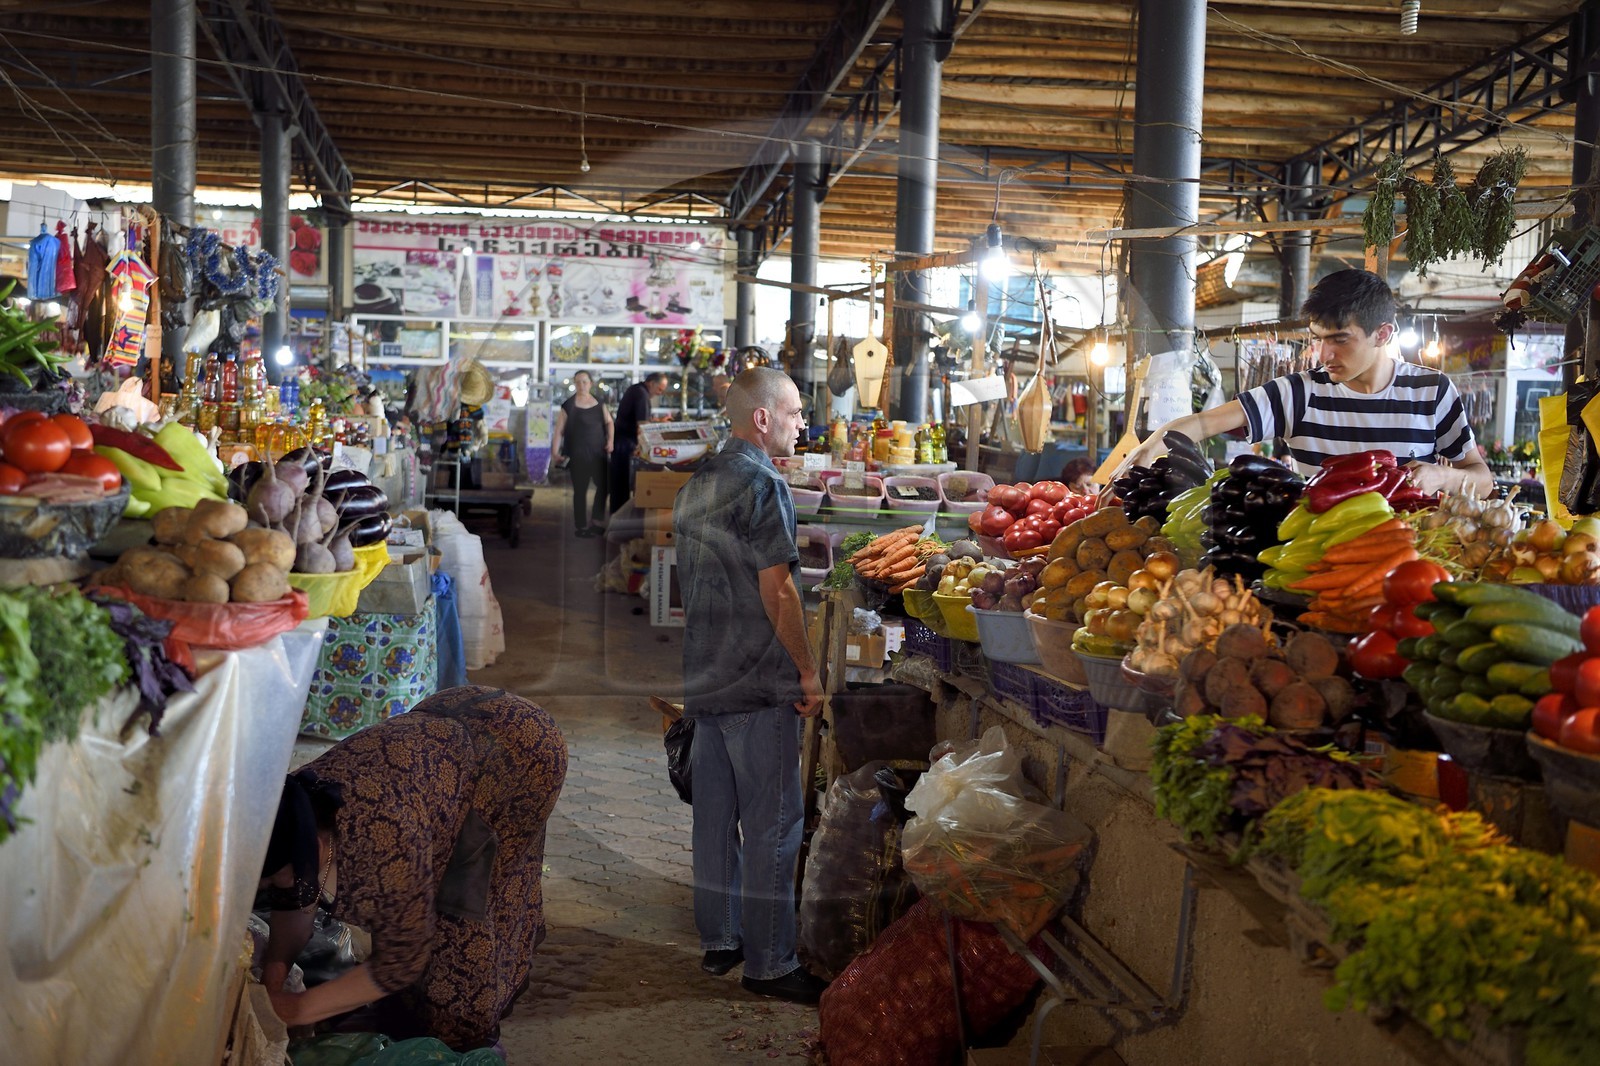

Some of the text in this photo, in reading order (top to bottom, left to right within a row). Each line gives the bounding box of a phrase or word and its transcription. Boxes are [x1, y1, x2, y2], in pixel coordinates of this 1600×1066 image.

[653, 446, 678, 456] Dole
[657, 563, 665, 592] PREMIUM
[657, 594, 665, 623] BANANAS
